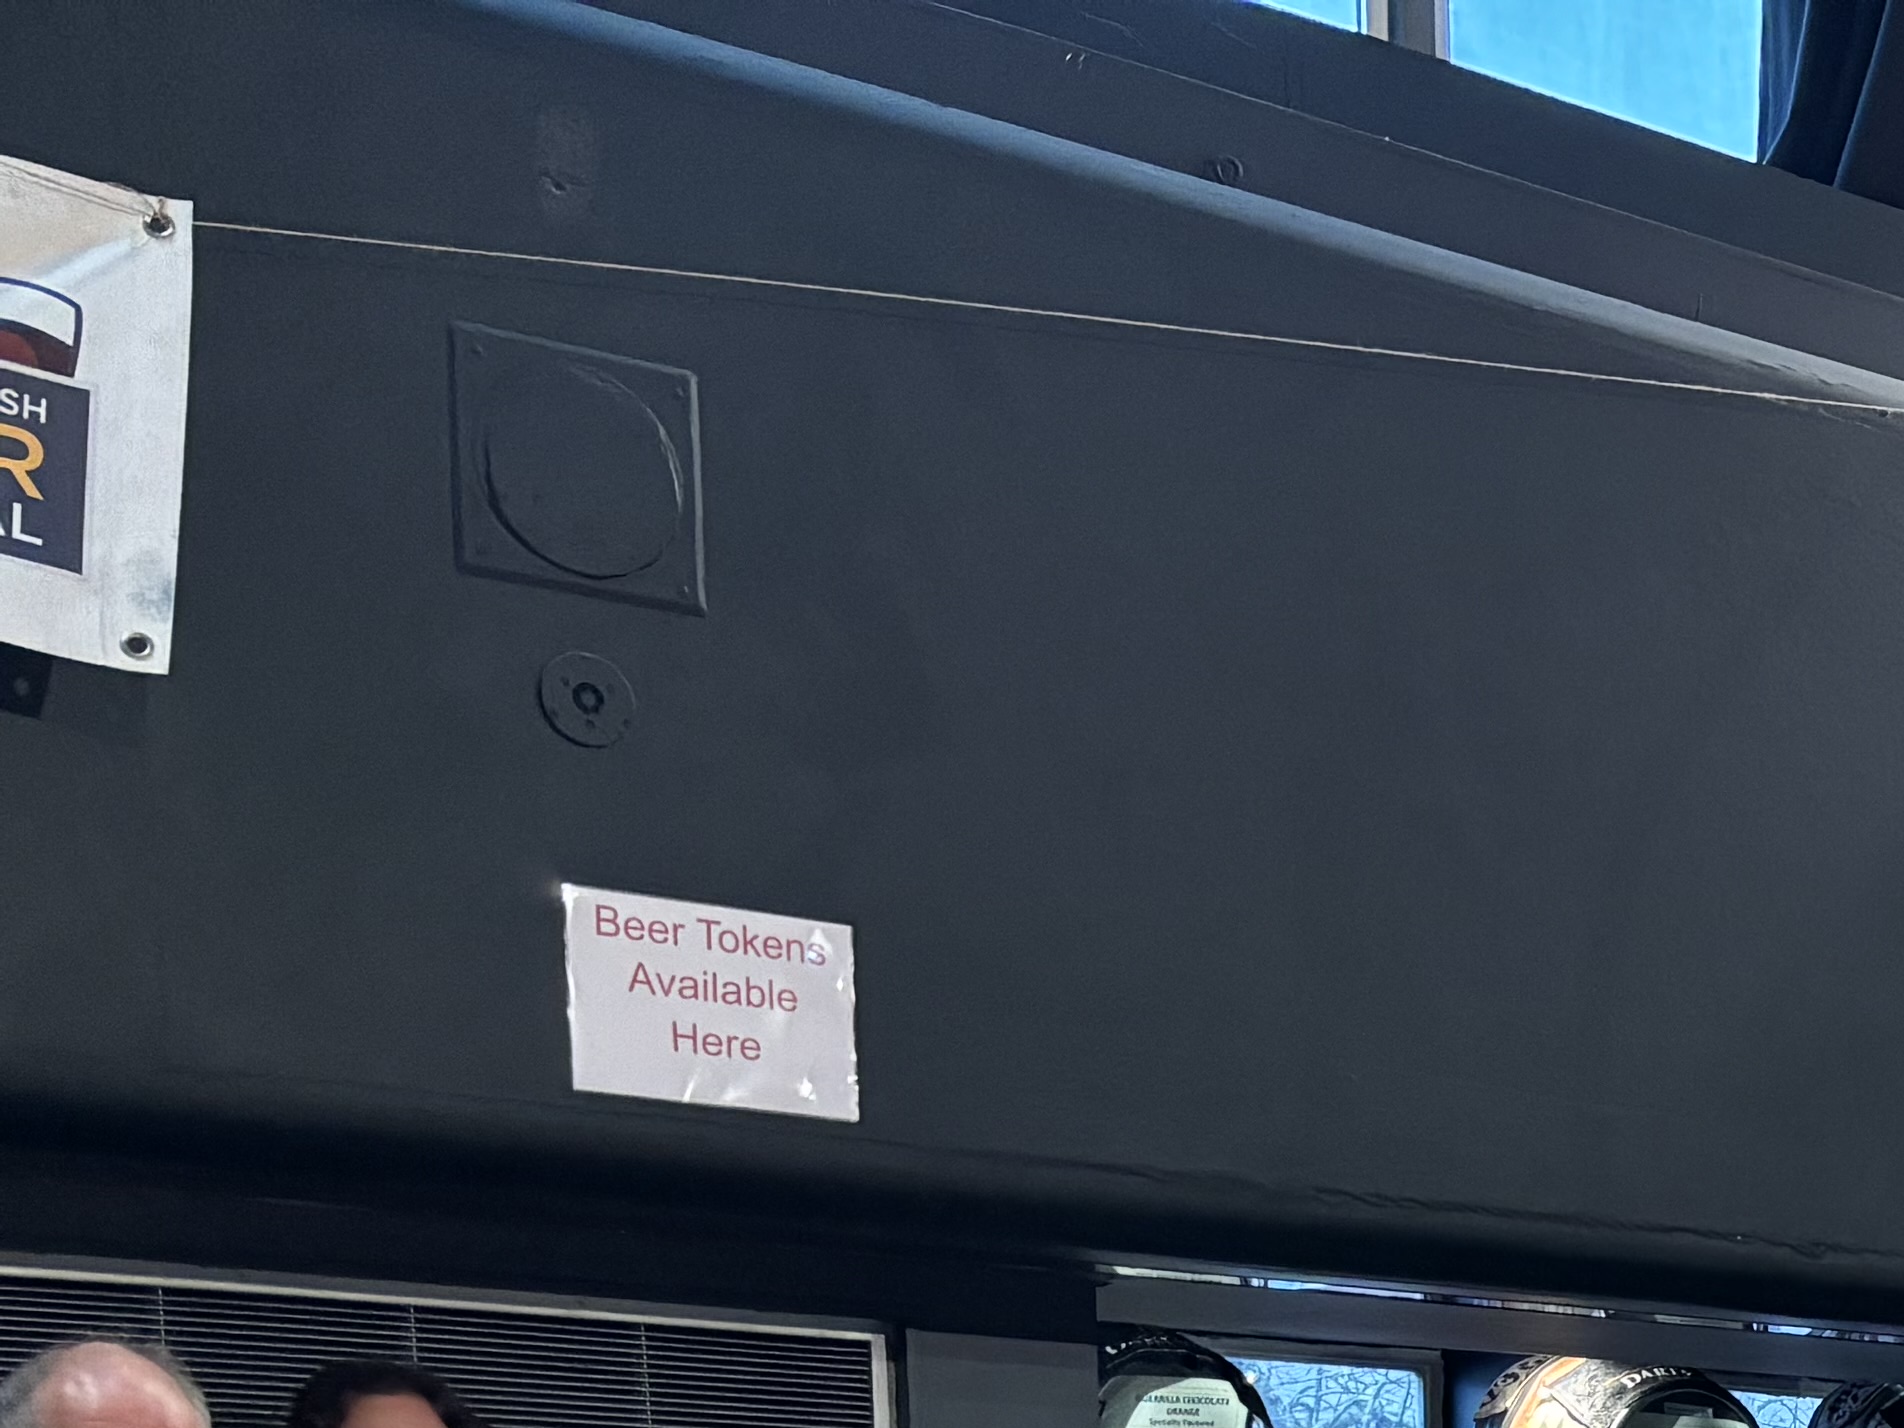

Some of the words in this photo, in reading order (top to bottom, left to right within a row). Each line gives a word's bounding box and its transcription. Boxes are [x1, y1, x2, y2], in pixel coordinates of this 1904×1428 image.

[595, 904, 685, 946] Beer
[696, 918, 827, 966] Tokens
[628, 962, 798, 1012] Available
[672, 1020, 762, 1061] Here
